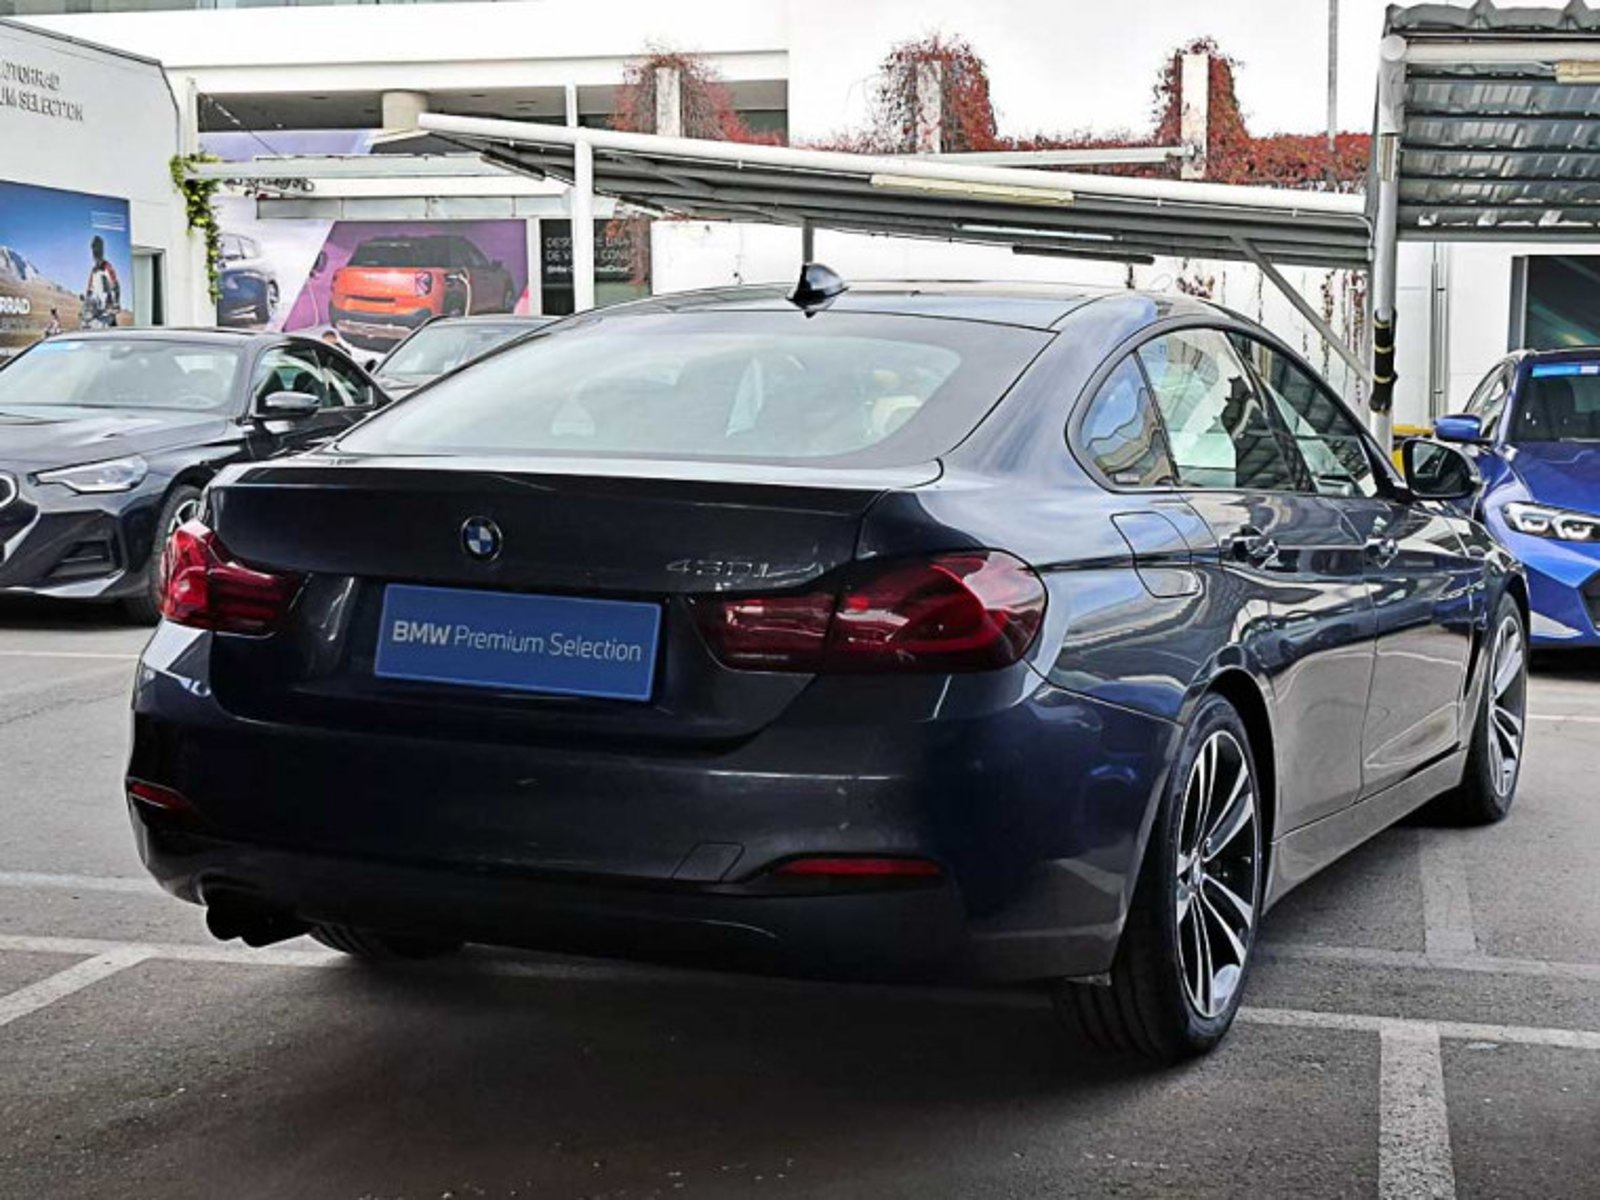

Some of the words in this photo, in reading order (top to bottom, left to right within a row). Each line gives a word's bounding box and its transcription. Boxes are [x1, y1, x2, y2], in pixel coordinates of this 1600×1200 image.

[392, 620, 451, 645] BMW
[454, 624, 545, 654] Premium
[548, 632, 642, 662] Selection
